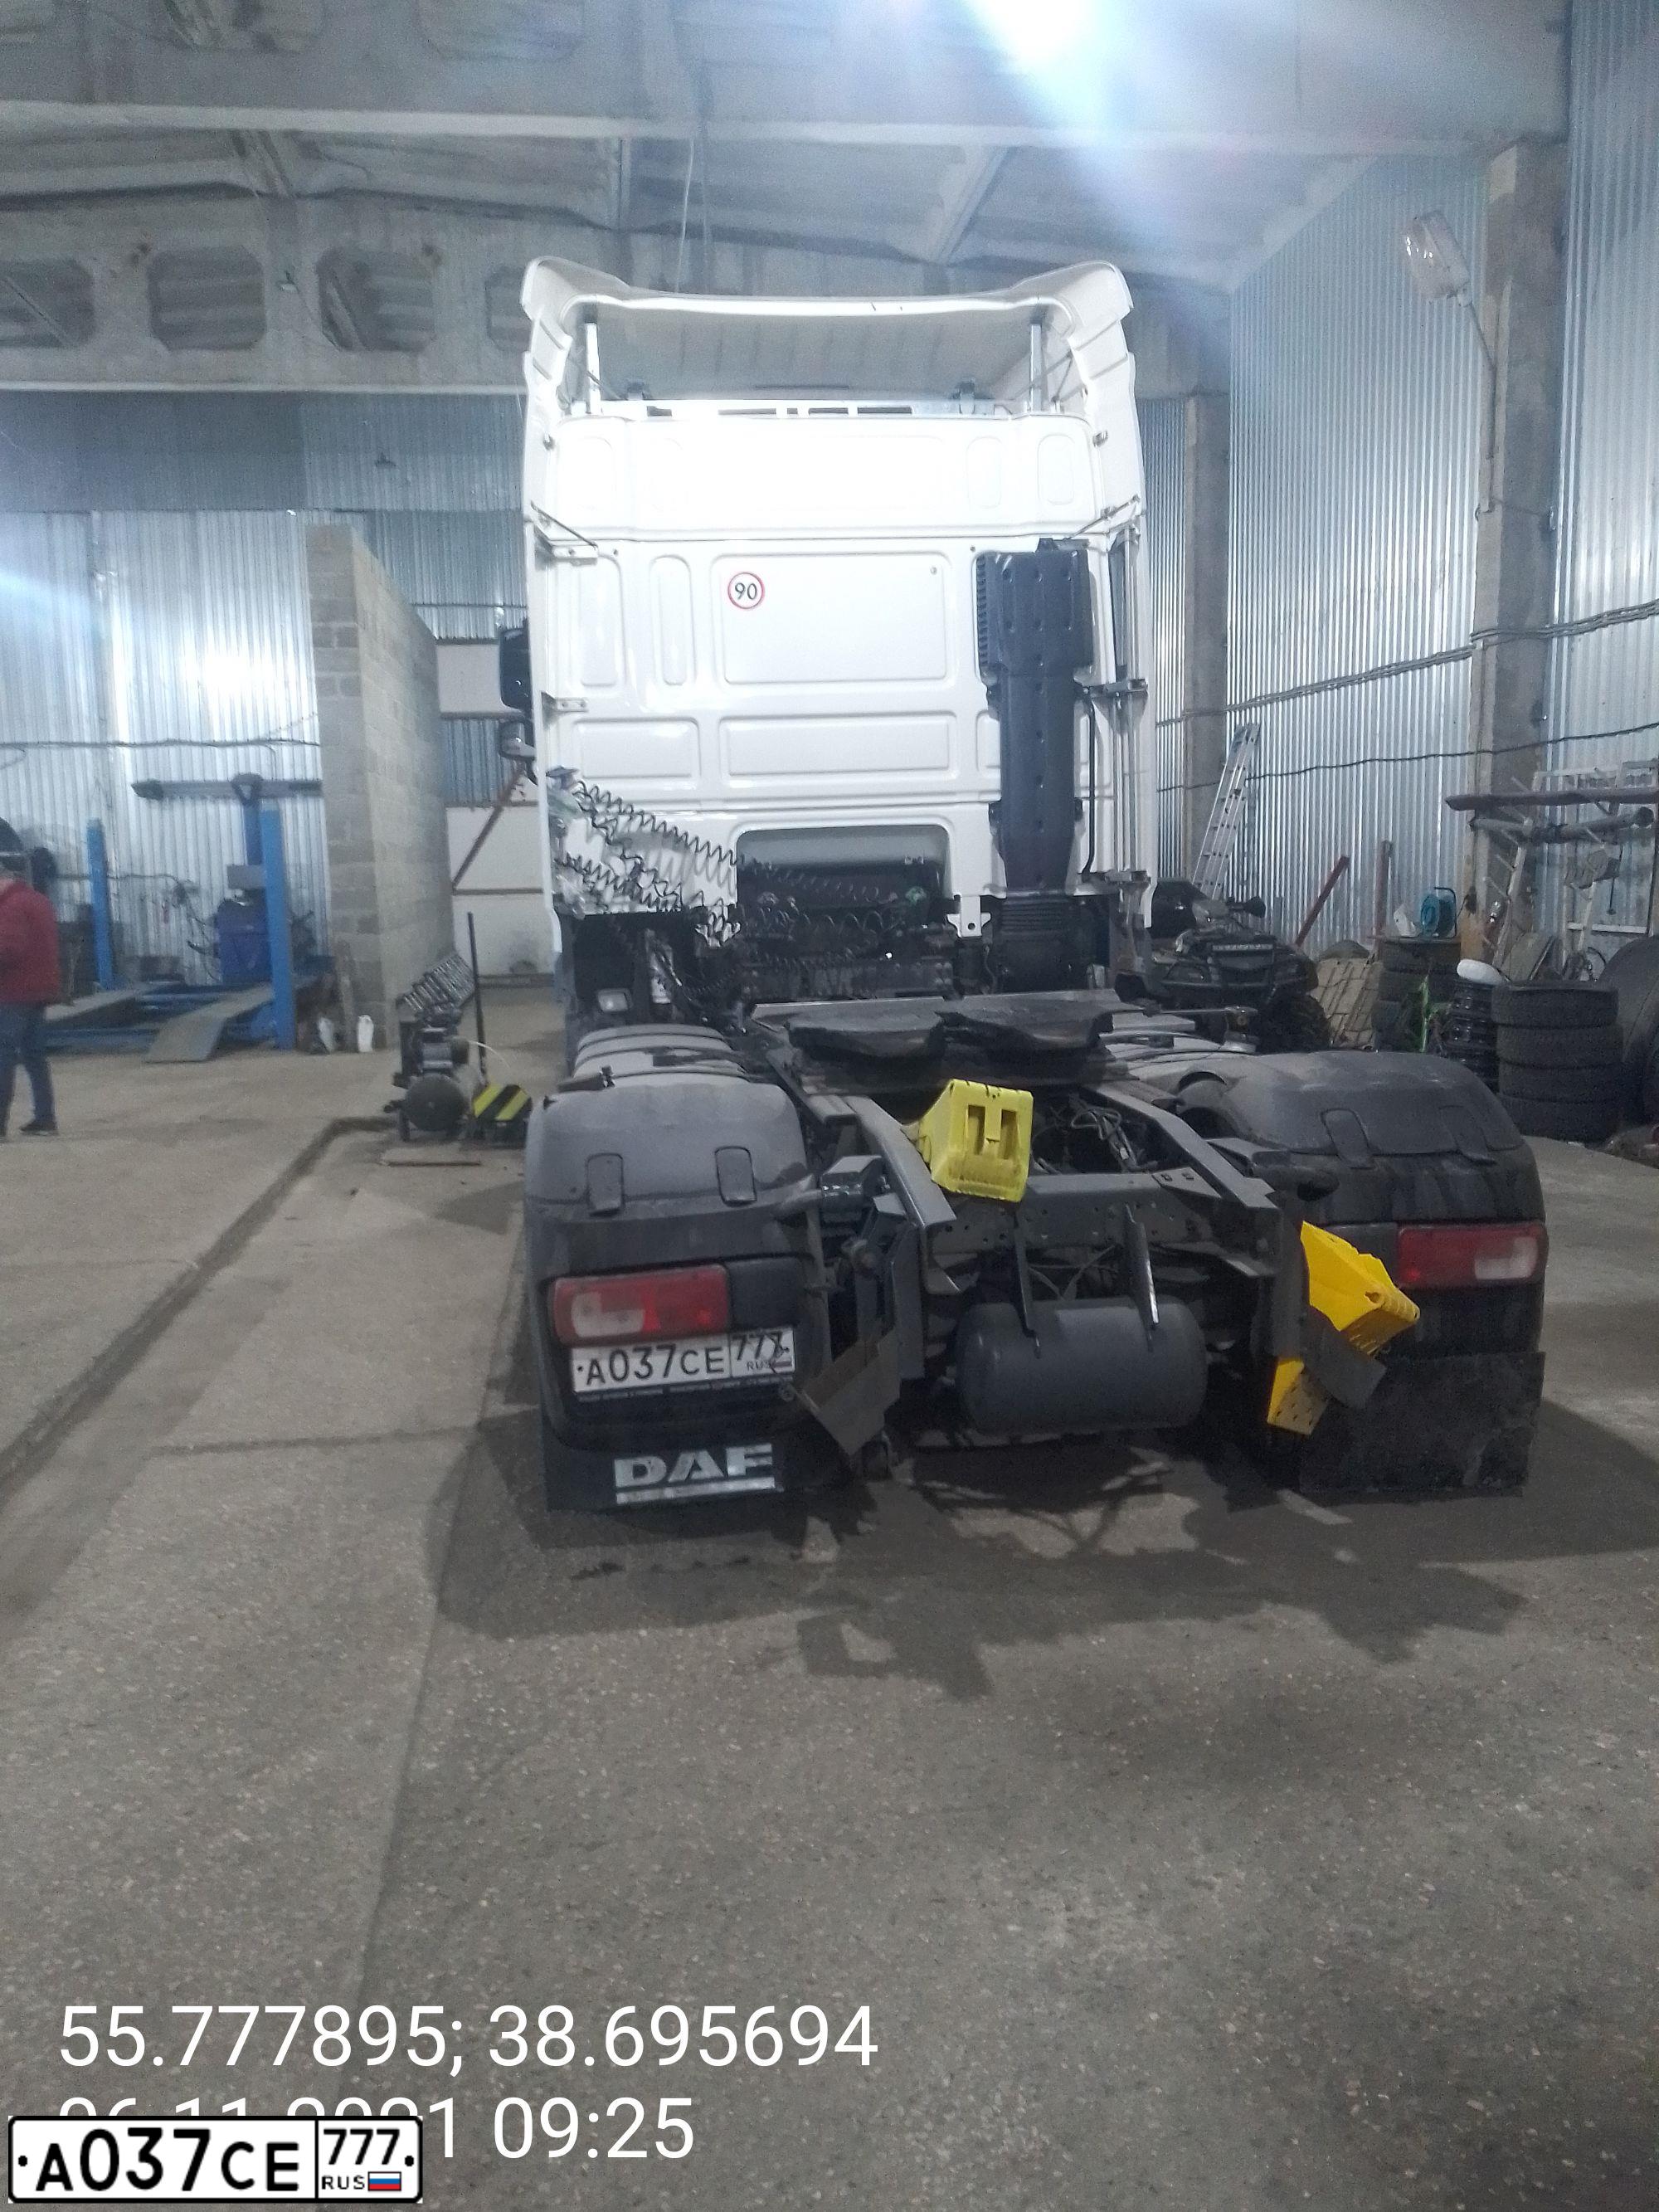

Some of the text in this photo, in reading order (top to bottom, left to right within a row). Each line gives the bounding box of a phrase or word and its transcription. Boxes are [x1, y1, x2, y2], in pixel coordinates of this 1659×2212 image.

[735, 582, 757, 600] 90
[586, 1343, 724, 1386] A037CE
[614, 1443, 773, 1488] DAF
